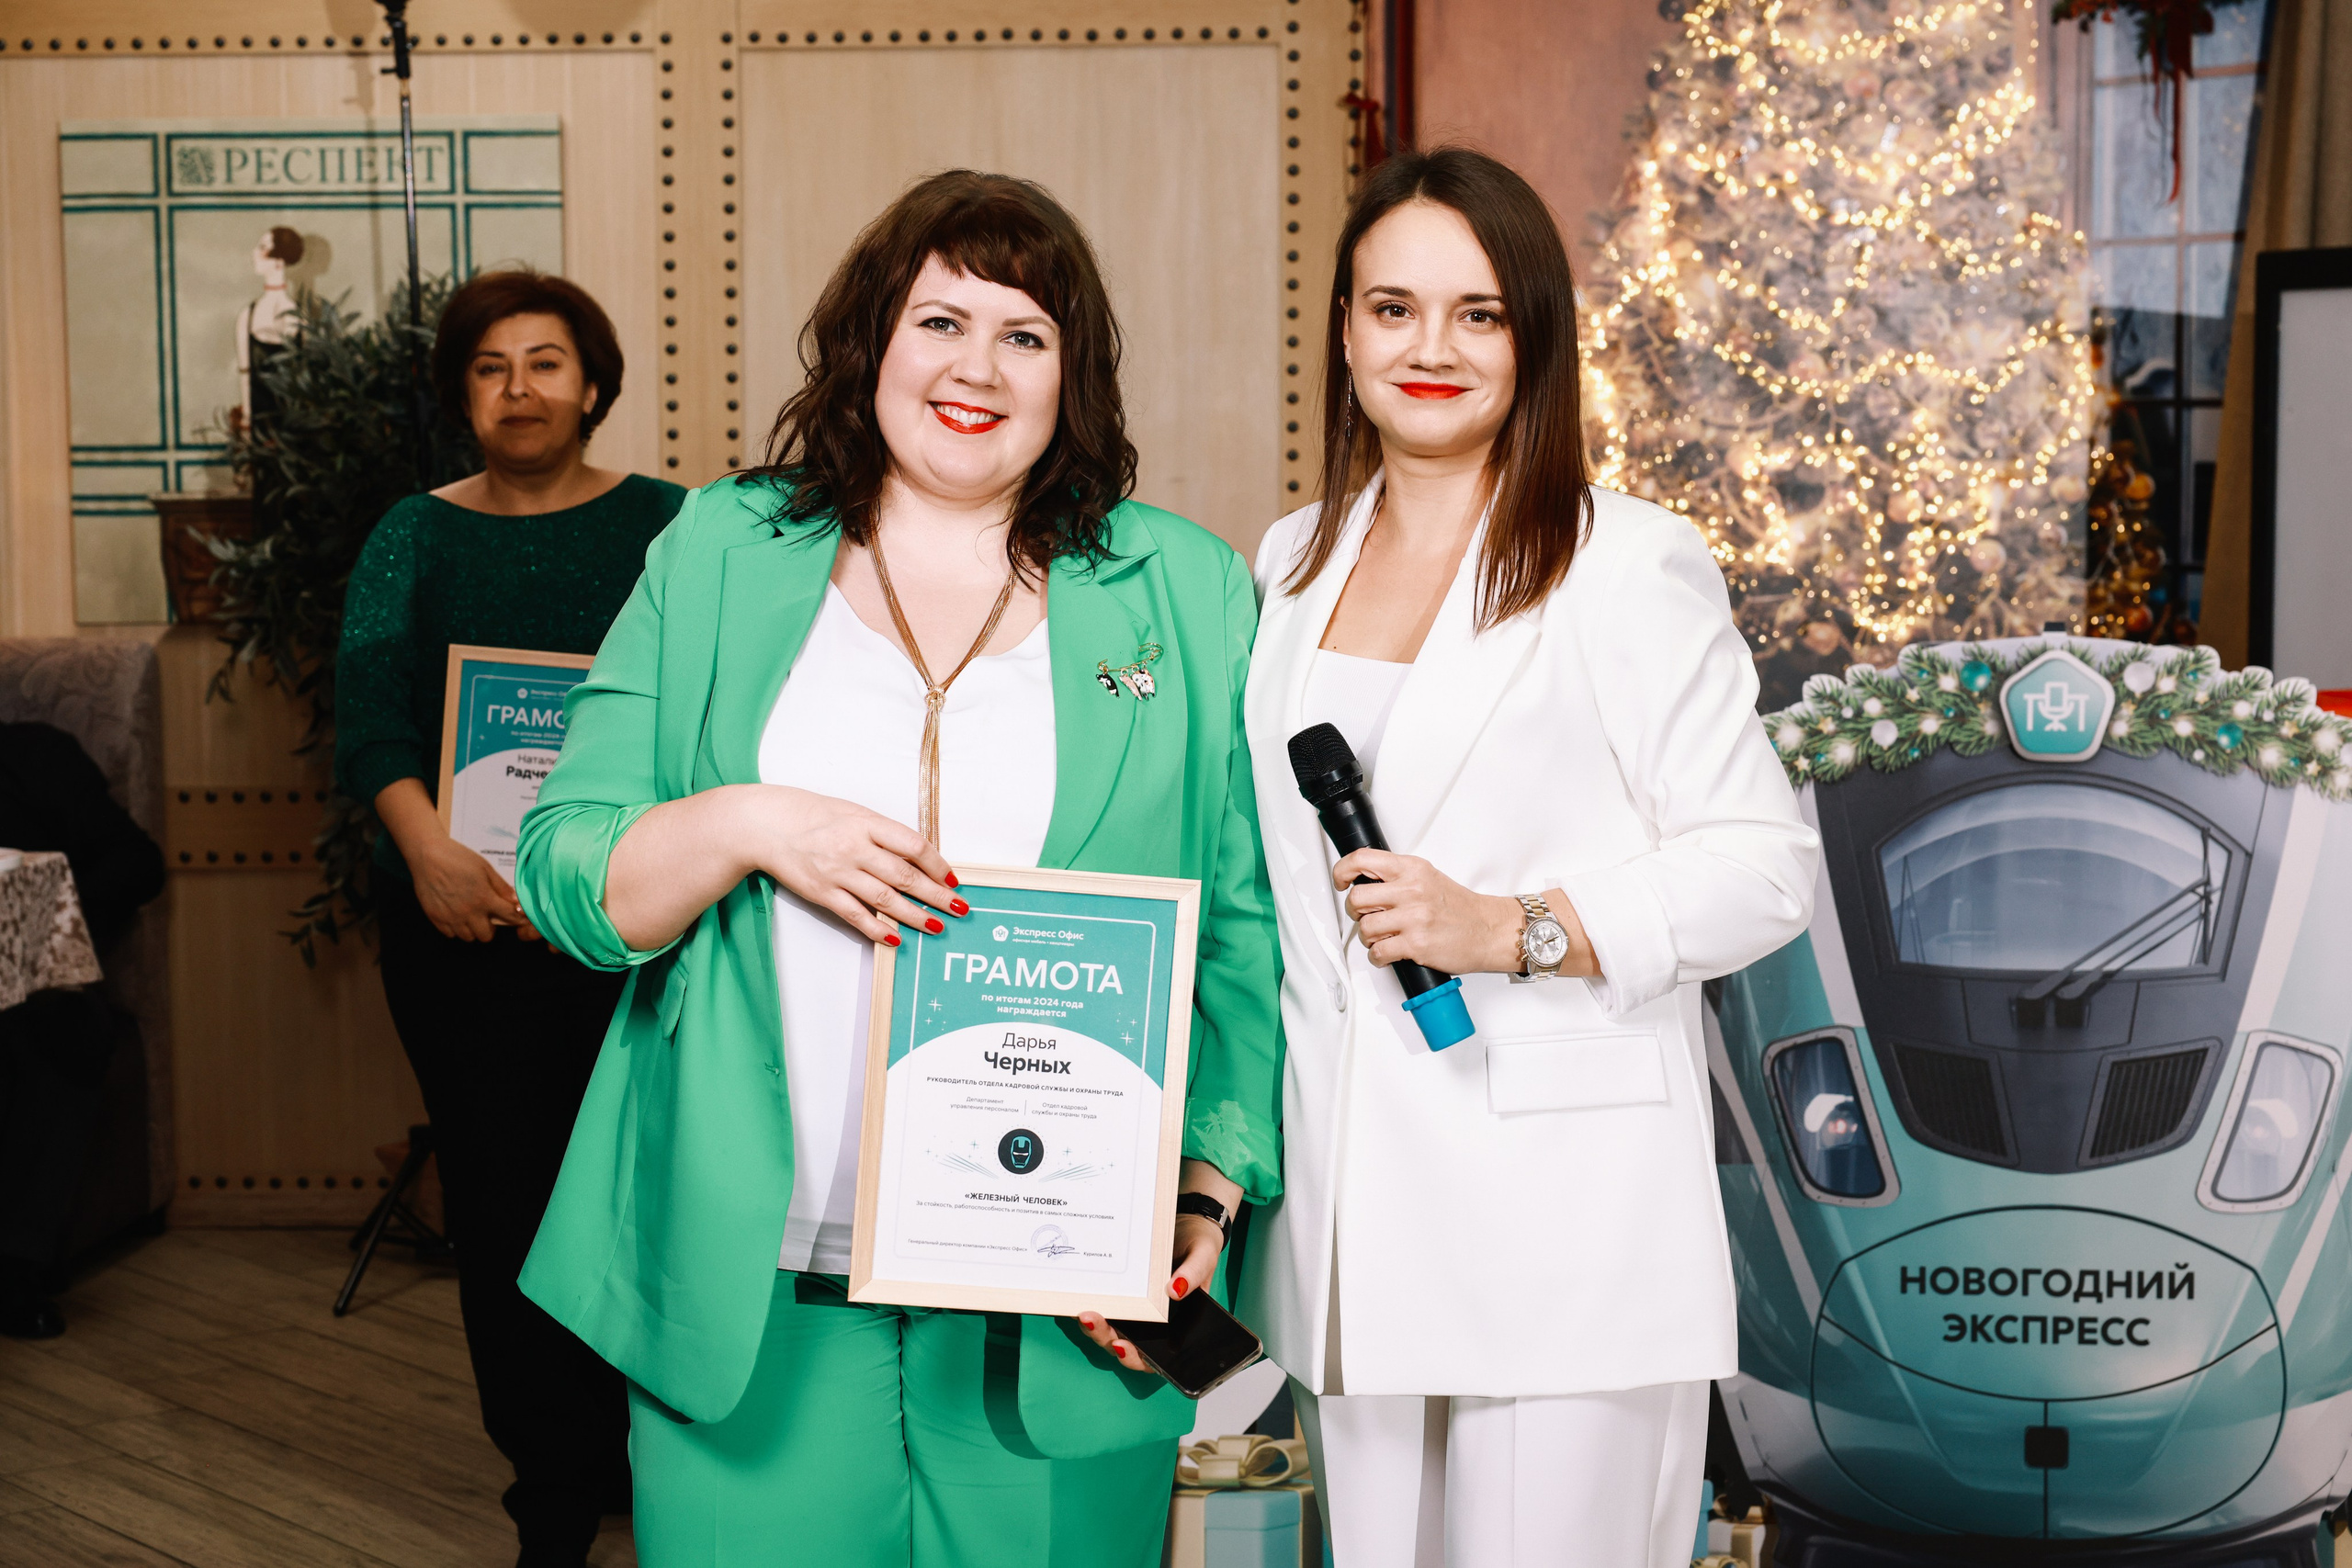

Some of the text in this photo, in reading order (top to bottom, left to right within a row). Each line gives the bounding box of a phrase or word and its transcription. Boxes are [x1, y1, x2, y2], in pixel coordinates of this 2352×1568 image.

[224, 145, 445, 184] РЕСПЕКТ
[1012, 927, 1084, 942] Экспресс Офис
[943, 952, 1124, 995] ГРАМОТА
[981, 994, 1084, 1009] по итогам 2024 года
[997, 1006, 1067, 1018] награждается
[1001, 1032, 1057, 1052] Дарья
[984, 1051, 1071, 1076] Черных
[926, 1077, 978, 1086] РУКОВОДИТЕЛЬ
[1004, 1082, 1040, 1090] КАДРОВОЙ
[1040, 1085, 1069, 1093] СЛУЖБЫ
[966, 1096, 1004, 1104] Департамент
[984, 1105, 1019, 1113] персоналом
[965, 1192, 1069, 1207] «ЖЕЛЕЗНЫЙ ЧЕЛОВЕК»
[1900, 1262, 2196, 1303] НОВОГОДНИЙ
[1942, 1314, 2151, 1347] ЭКСПРЕСС
